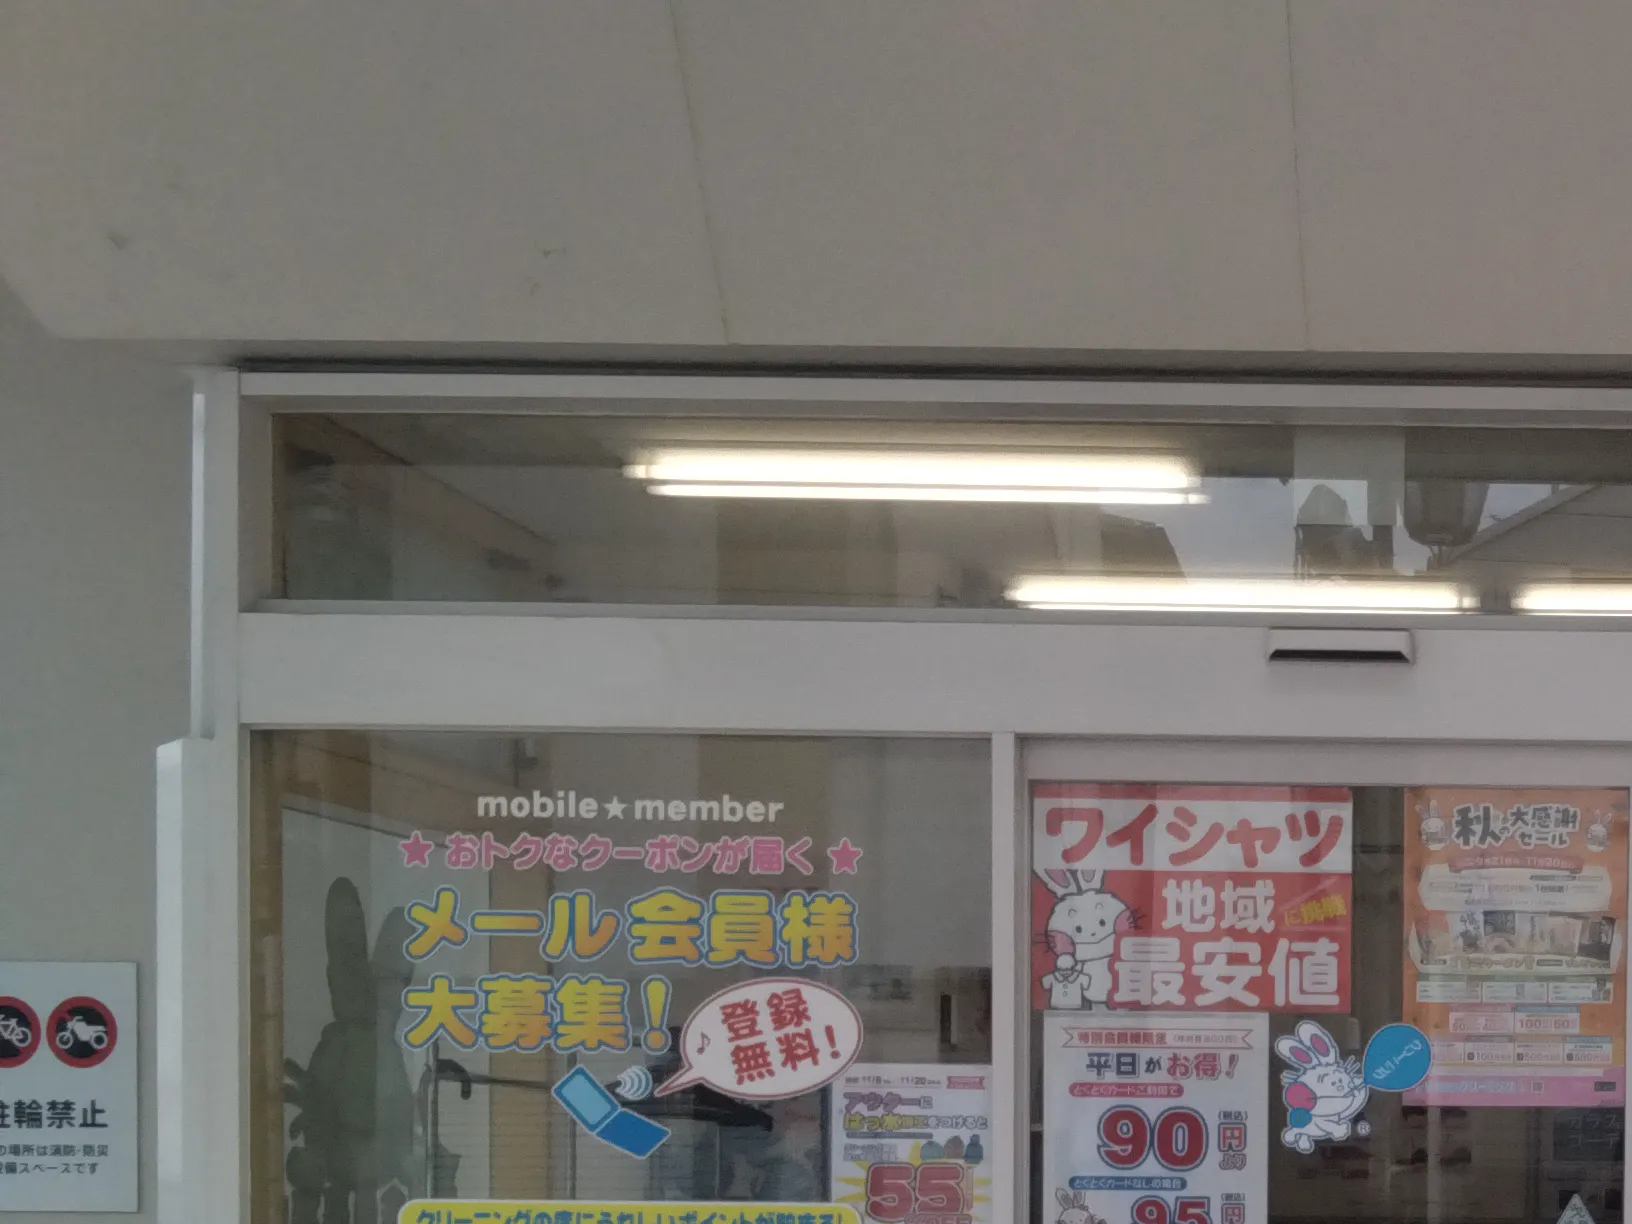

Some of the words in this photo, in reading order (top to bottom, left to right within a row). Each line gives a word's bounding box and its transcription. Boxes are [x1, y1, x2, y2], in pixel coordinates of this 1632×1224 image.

[477, 790, 599, 820] mobile
[634, 793, 785, 823] member
[1046, 803, 1344, 868] ワイシャツ
[445, 833, 814, 875] おトクなクーポンが届く
[404, 885, 859, 968] メール会員様
[1162, 878, 1276, 933] 地域
[1114, 936, 1341, 1008] 最安値
[404, 973, 672, 1053] 大募集!
[720, 988, 812, 1043] 登録
[730, 1024, 842, 1085] 無料!
[1086, 1052, 1239, 1080] 平日がお得!
[1096, 1104, 1209, 1172] 90
[1217, 1122, 1248, 1152] 円
[866, 1162, 965, 1224] 55
